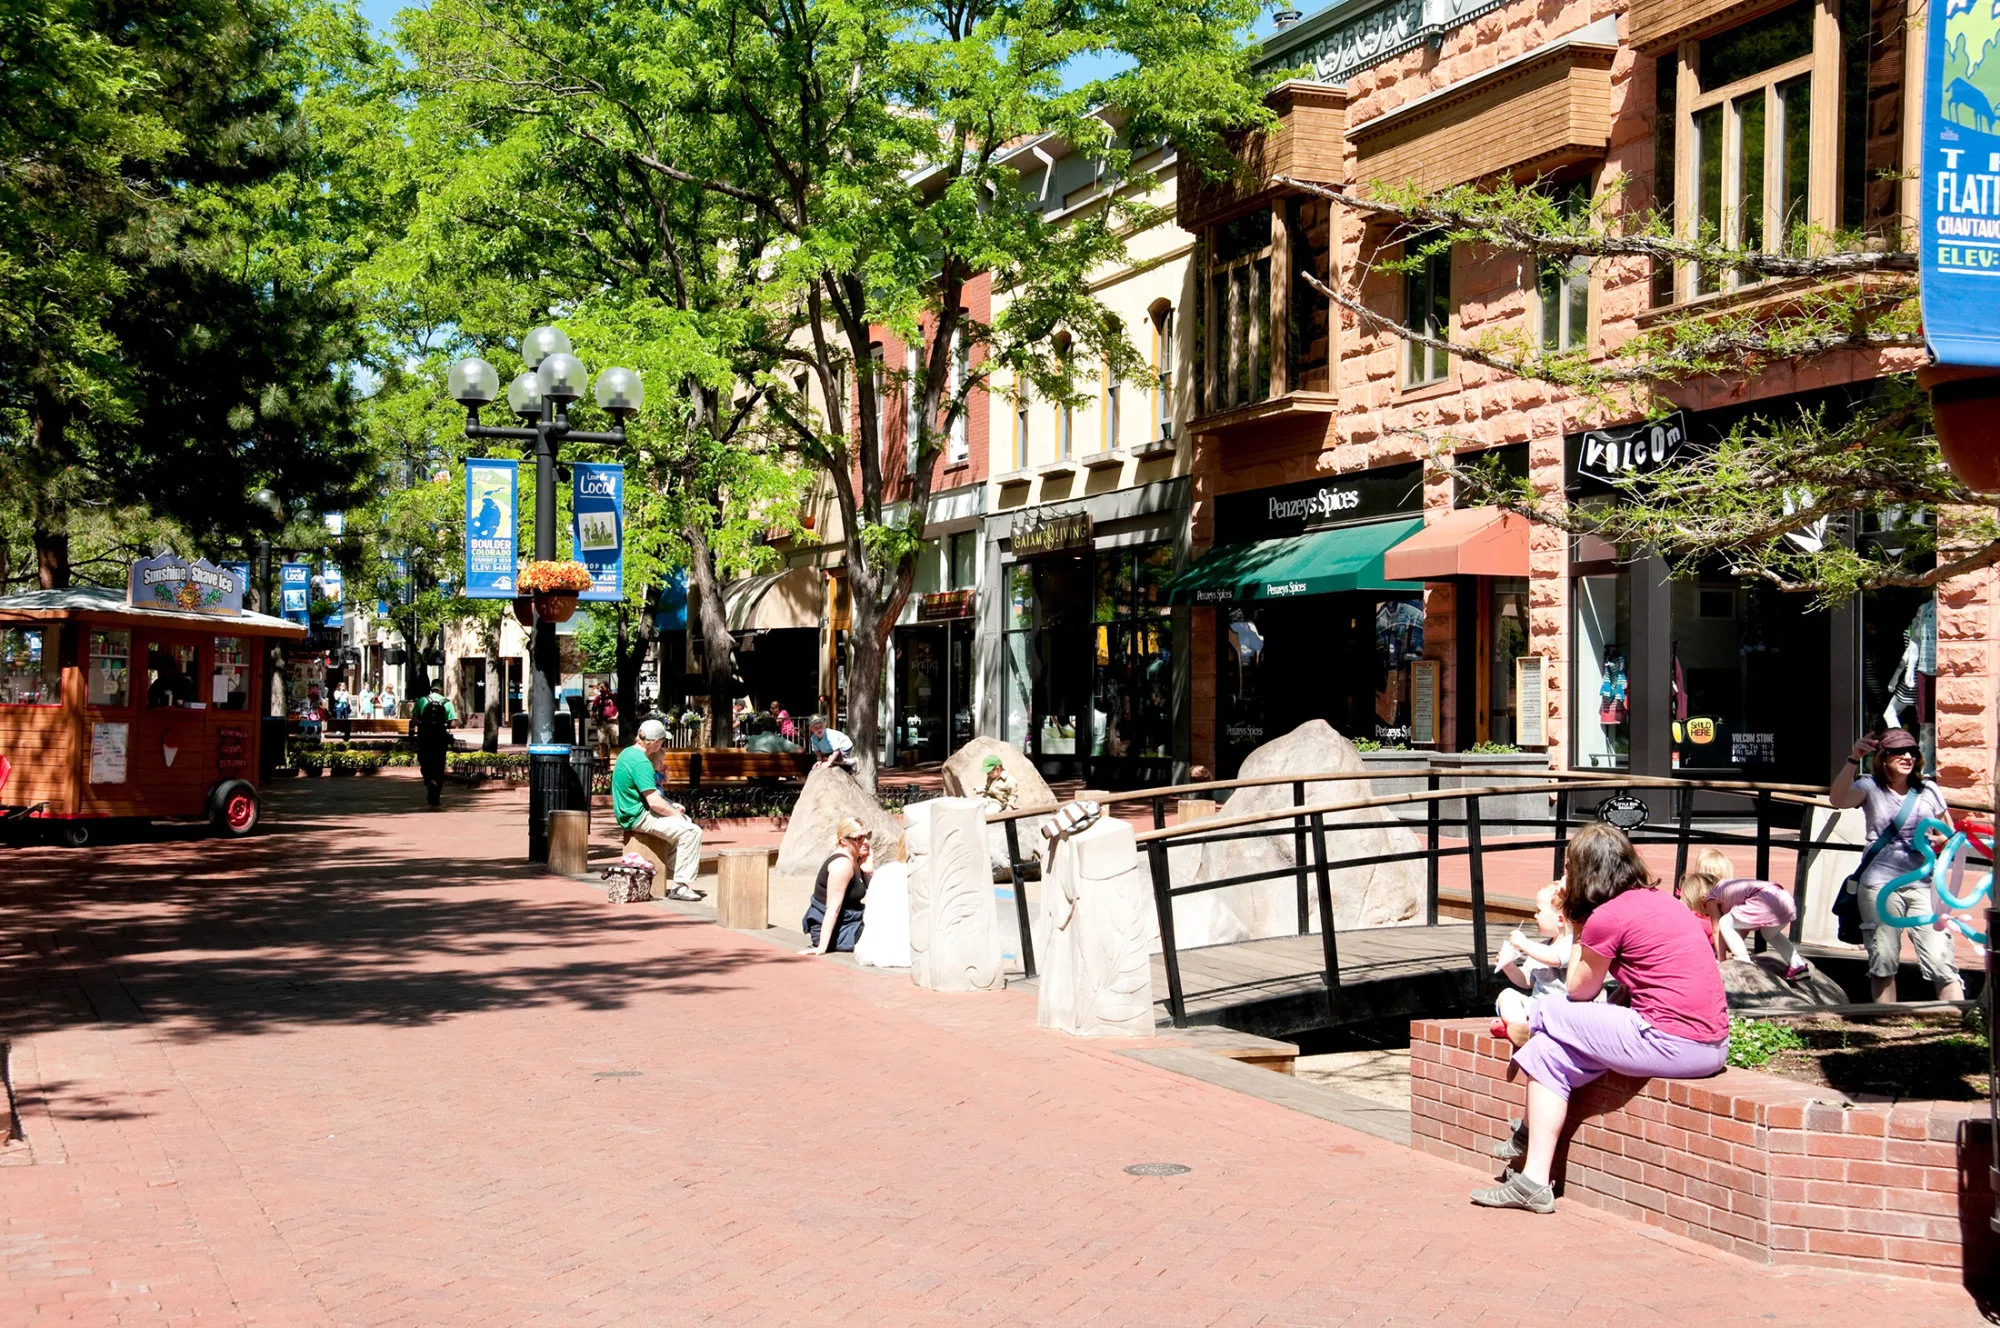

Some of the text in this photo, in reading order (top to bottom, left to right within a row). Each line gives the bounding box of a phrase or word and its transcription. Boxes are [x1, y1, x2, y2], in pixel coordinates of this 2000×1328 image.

[1938, 247, 2000, 268] ELEV:
[581, 475, 616, 496] Local
[1268, 487, 1359, 521] Penzeys Spices
[471, 539, 511, 549] BOULDER
[1014, 524, 1087, 549] GAIAM LIVING
[144, 565, 187, 584] Sunshine
[192, 566, 217, 586] Shave
[219, 574, 233, 592] Ice
[1216, 589, 1232, 602] Spices
[1267, 581, 1307, 596] Penzeys Spices
[1375, 724, 1401, 740] Penzeys
[1732, 733, 1755, 743] VOLCOM
